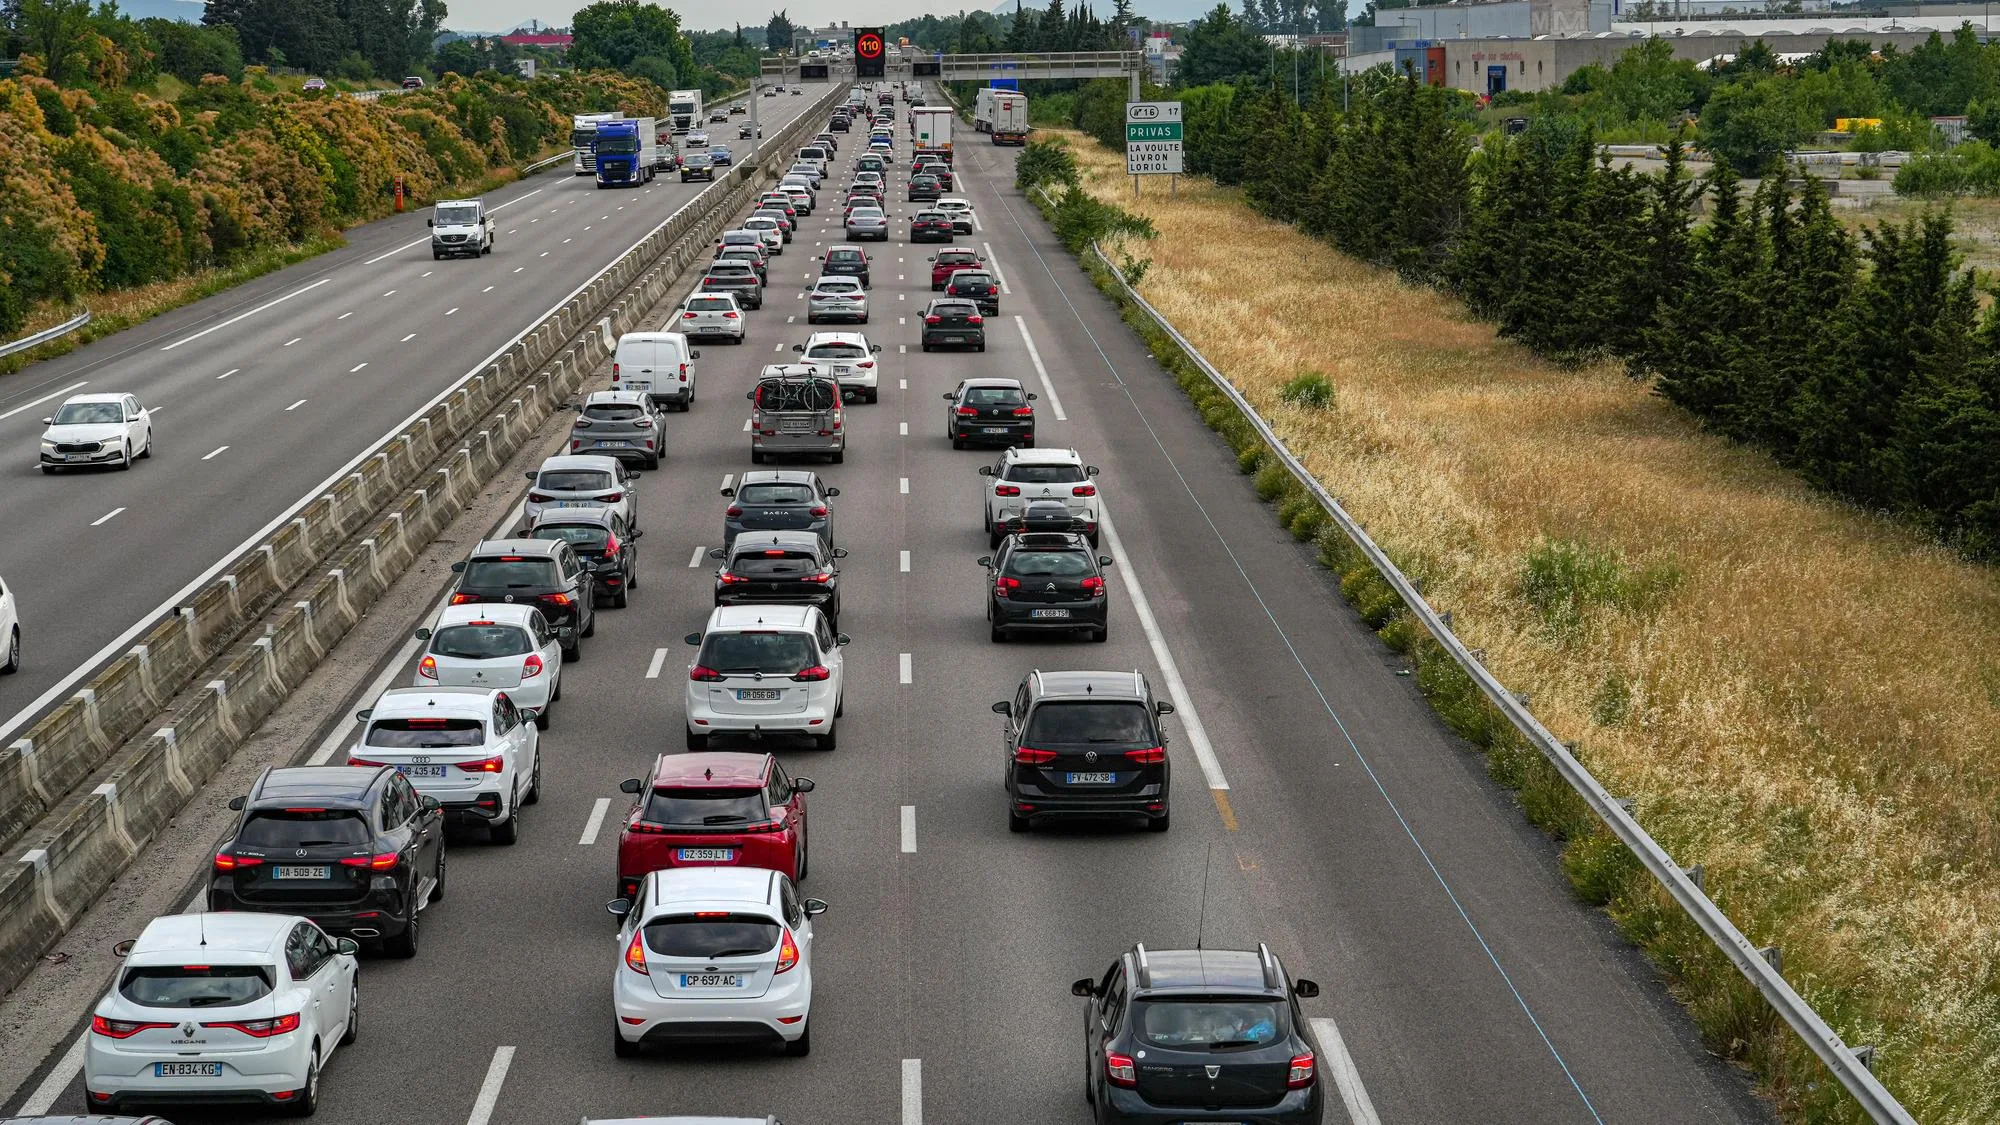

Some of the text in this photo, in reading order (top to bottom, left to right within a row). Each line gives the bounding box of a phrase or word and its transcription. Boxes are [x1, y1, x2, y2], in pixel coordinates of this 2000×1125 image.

[861, 40, 879, 51] 110
[1144, 107, 1179, 116] 16 17
[1130, 126, 1171, 137] PRIVAS
[1130, 143, 1180, 152] LA VOULTE
[1130, 153, 1168, 161] LIVRON
[1130, 163, 1168, 172] LORIOL
[402, 766, 440, 776] HB-435-AZ
[1072, 773, 1110, 782] FV-472-SB
[684, 850, 726, 860] GZ-359-LT
[280, 866, 323, 877] HA-509-ZE
[687, 975, 736, 986] CP-697-AC
[162, 1063, 215, 1075] EN-834-KG
